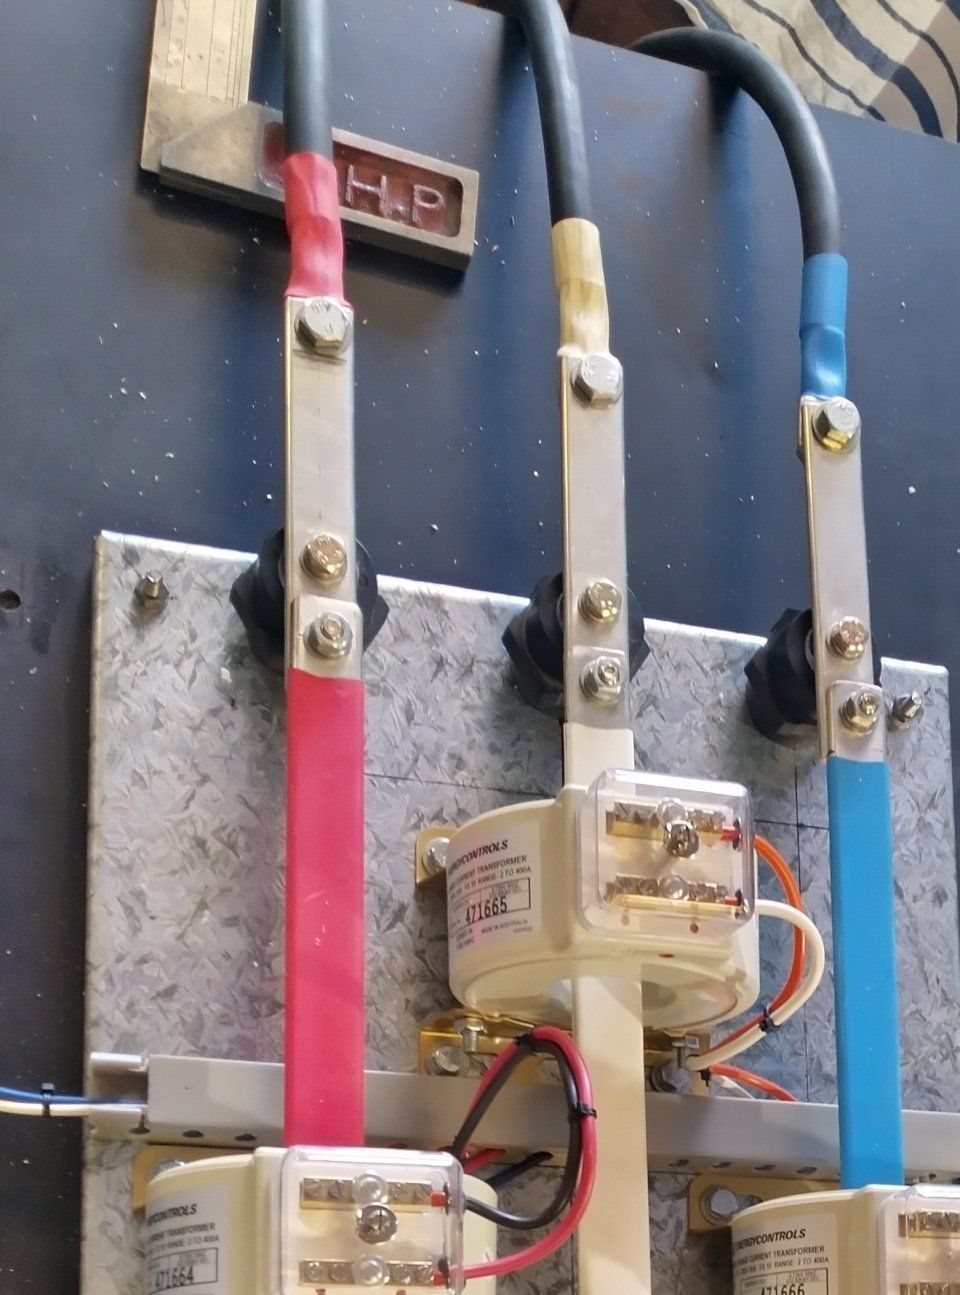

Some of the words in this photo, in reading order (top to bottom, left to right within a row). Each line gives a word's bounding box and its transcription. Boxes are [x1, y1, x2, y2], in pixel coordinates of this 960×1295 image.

[477, 855, 527, 873] TRANSFORMER
[465, 896, 508, 925] 471665
[773, 1246, 825, 1257] TRANSFORMER
[155, 1265, 194, 1289] 471664
